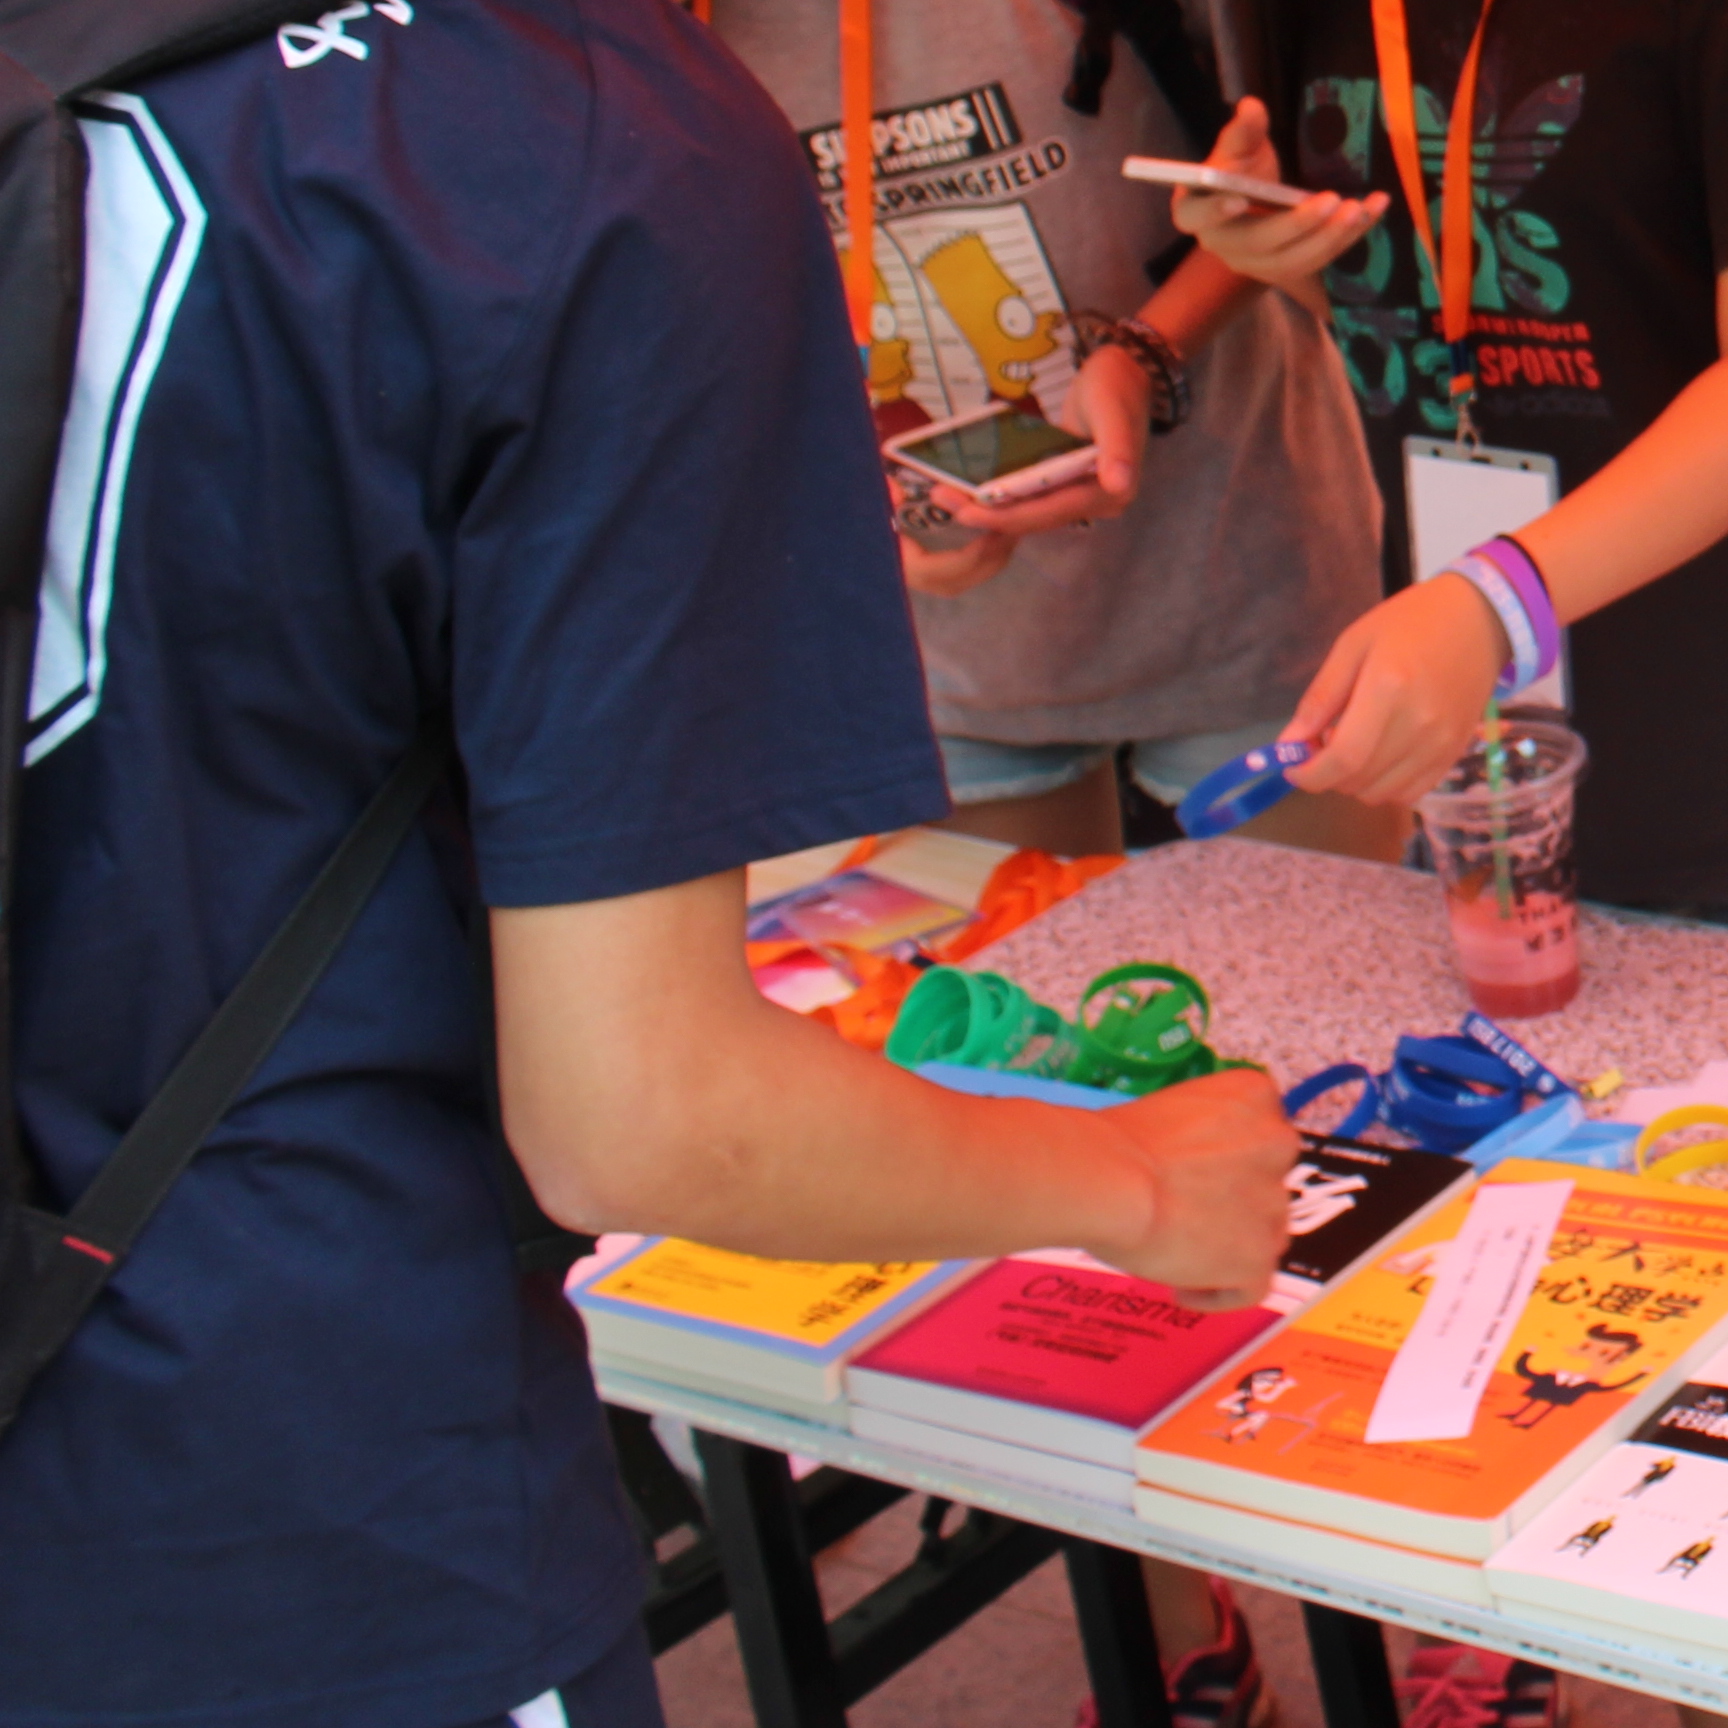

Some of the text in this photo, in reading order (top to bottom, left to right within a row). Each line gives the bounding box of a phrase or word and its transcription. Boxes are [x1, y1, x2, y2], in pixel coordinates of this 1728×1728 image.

[810, 98, 978, 170] SIPSONS
[1477, 343, 1602, 390] SPORTS
[1020, 1273, 1206, 1332] Charisma
[1533, 1273, 1704, 1323] 心理学
